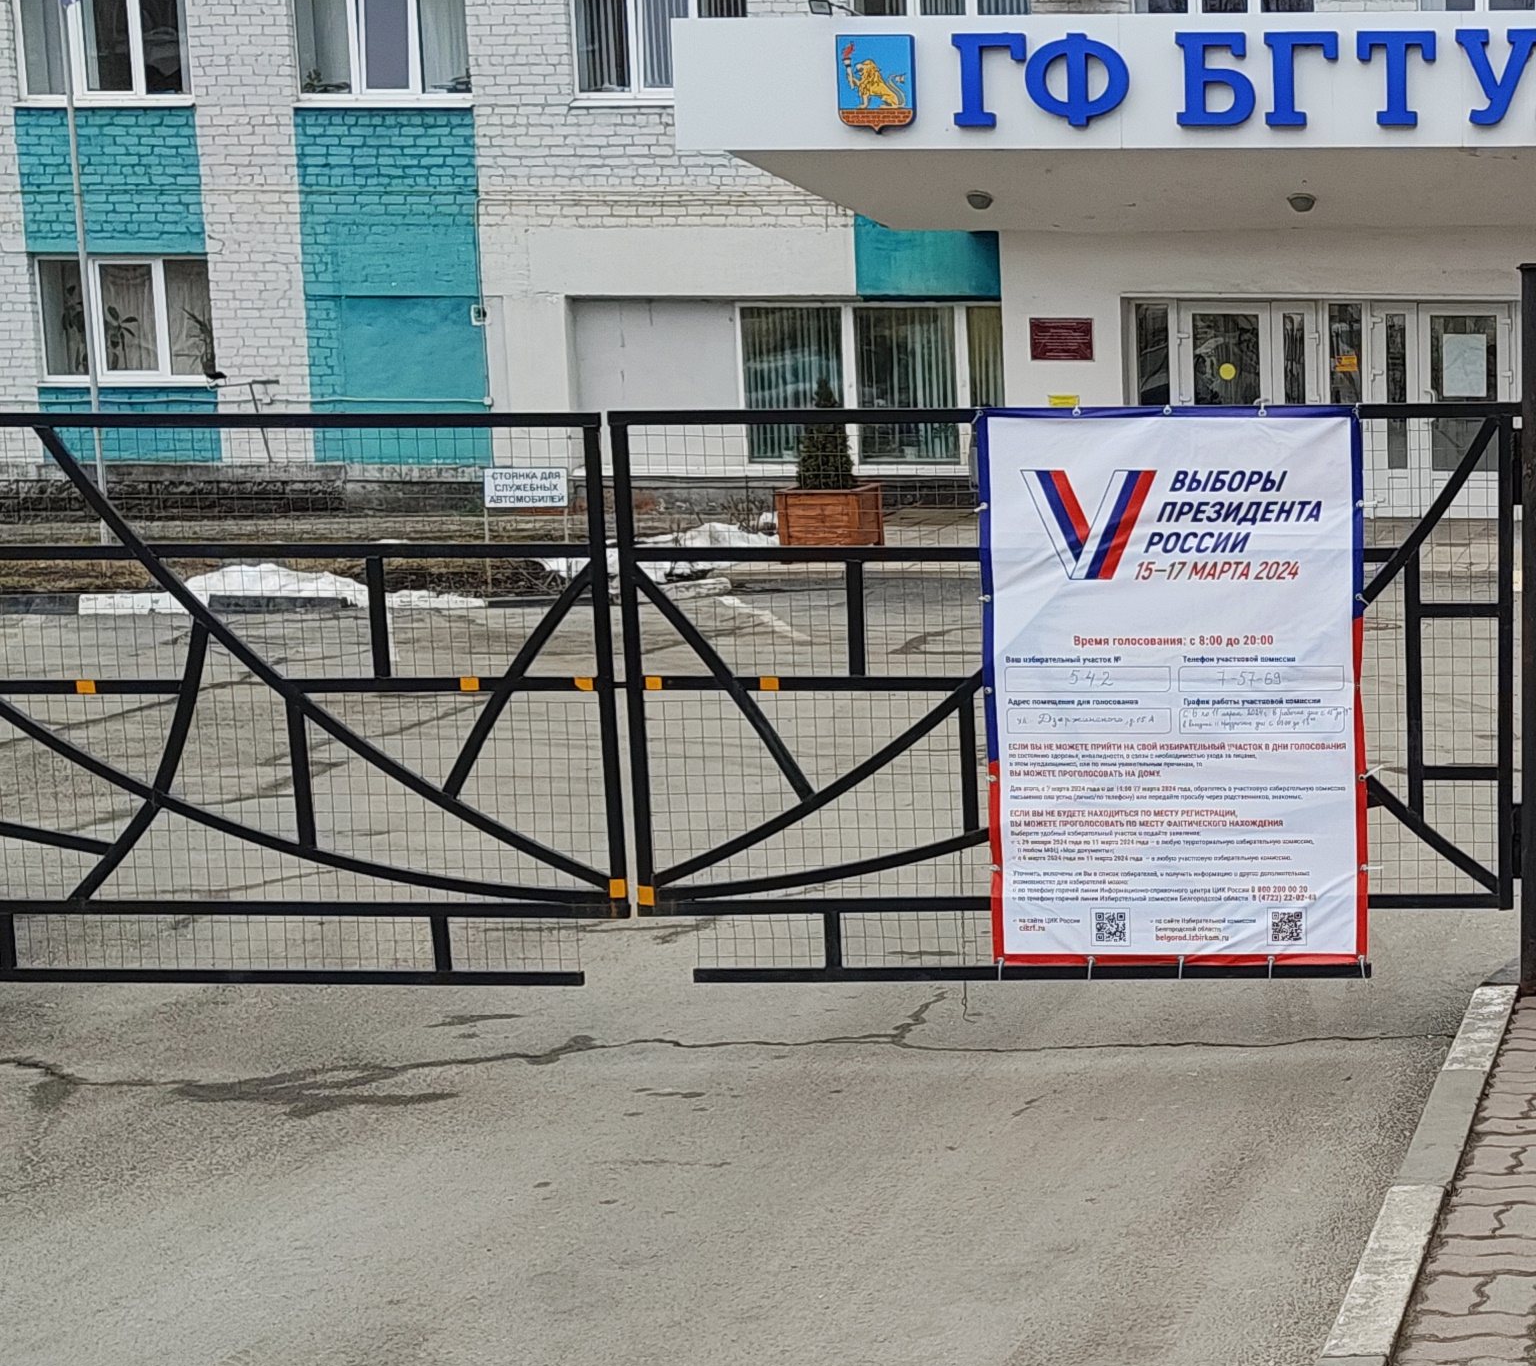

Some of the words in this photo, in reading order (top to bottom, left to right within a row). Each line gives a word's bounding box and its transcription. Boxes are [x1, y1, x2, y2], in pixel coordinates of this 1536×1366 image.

[952, 32, 1130, 127] ГФ
[492, 472, 538, 480] СТОЯНКА
[540, 471, 561, 481] ДЛЯ
[1169, 470, 1288, 492] ВЫБОРЫ
[494, 483, 559, 492] СЛУЖЕБНЫХ
[489, 493, 565, 503] АВТОМОБИЛЕЙ
[1156, 501, 1323, 526] ПРЕЗИДЕНТА
[1143, 532, 1252, 554] РОССИИ
[1188, 562, 1251, 580] МАРТА
[1254, 561, 1300, 580] 2024
[1073, 635, 1109, 648] Время
[1112, 636, 1187, 646] голосования:
[1189, 637, 1196, 646] с
[1199, 636, 1223, 646] 8:00
[1226, 637, 1240, 647] до
[1243, 635, 1274, 645] 20:00
[1023, 656, 1080, 664] избирательный
[1082, 657, 1112, 665] участок
[1008, 698, 1030, 706] Адрес
[1183, 698, 1209, 706] График
[1212, 698, 1239, 706] работы
[1242, 697, 1284, 706] участковой
[1091, 742, 1122, 751] ПРИЙТИ
[1137, 742, 1157, 751] СВОЙ
[1159, 742, 1225, 751] ИЗБИРАТЕЛЬНЫЙ
[1272, 744, 1288, 752] ДНИ
[1138, 770, 1161, 778] ДОМУ.
[1057, 810, 1086, 818] БУДЕТЕ
[1088, 810, 1138, 818] НАХОДИТЬСЯ
[1181, 810, 1238, 818] РЕГИСТРАЦИИ,
